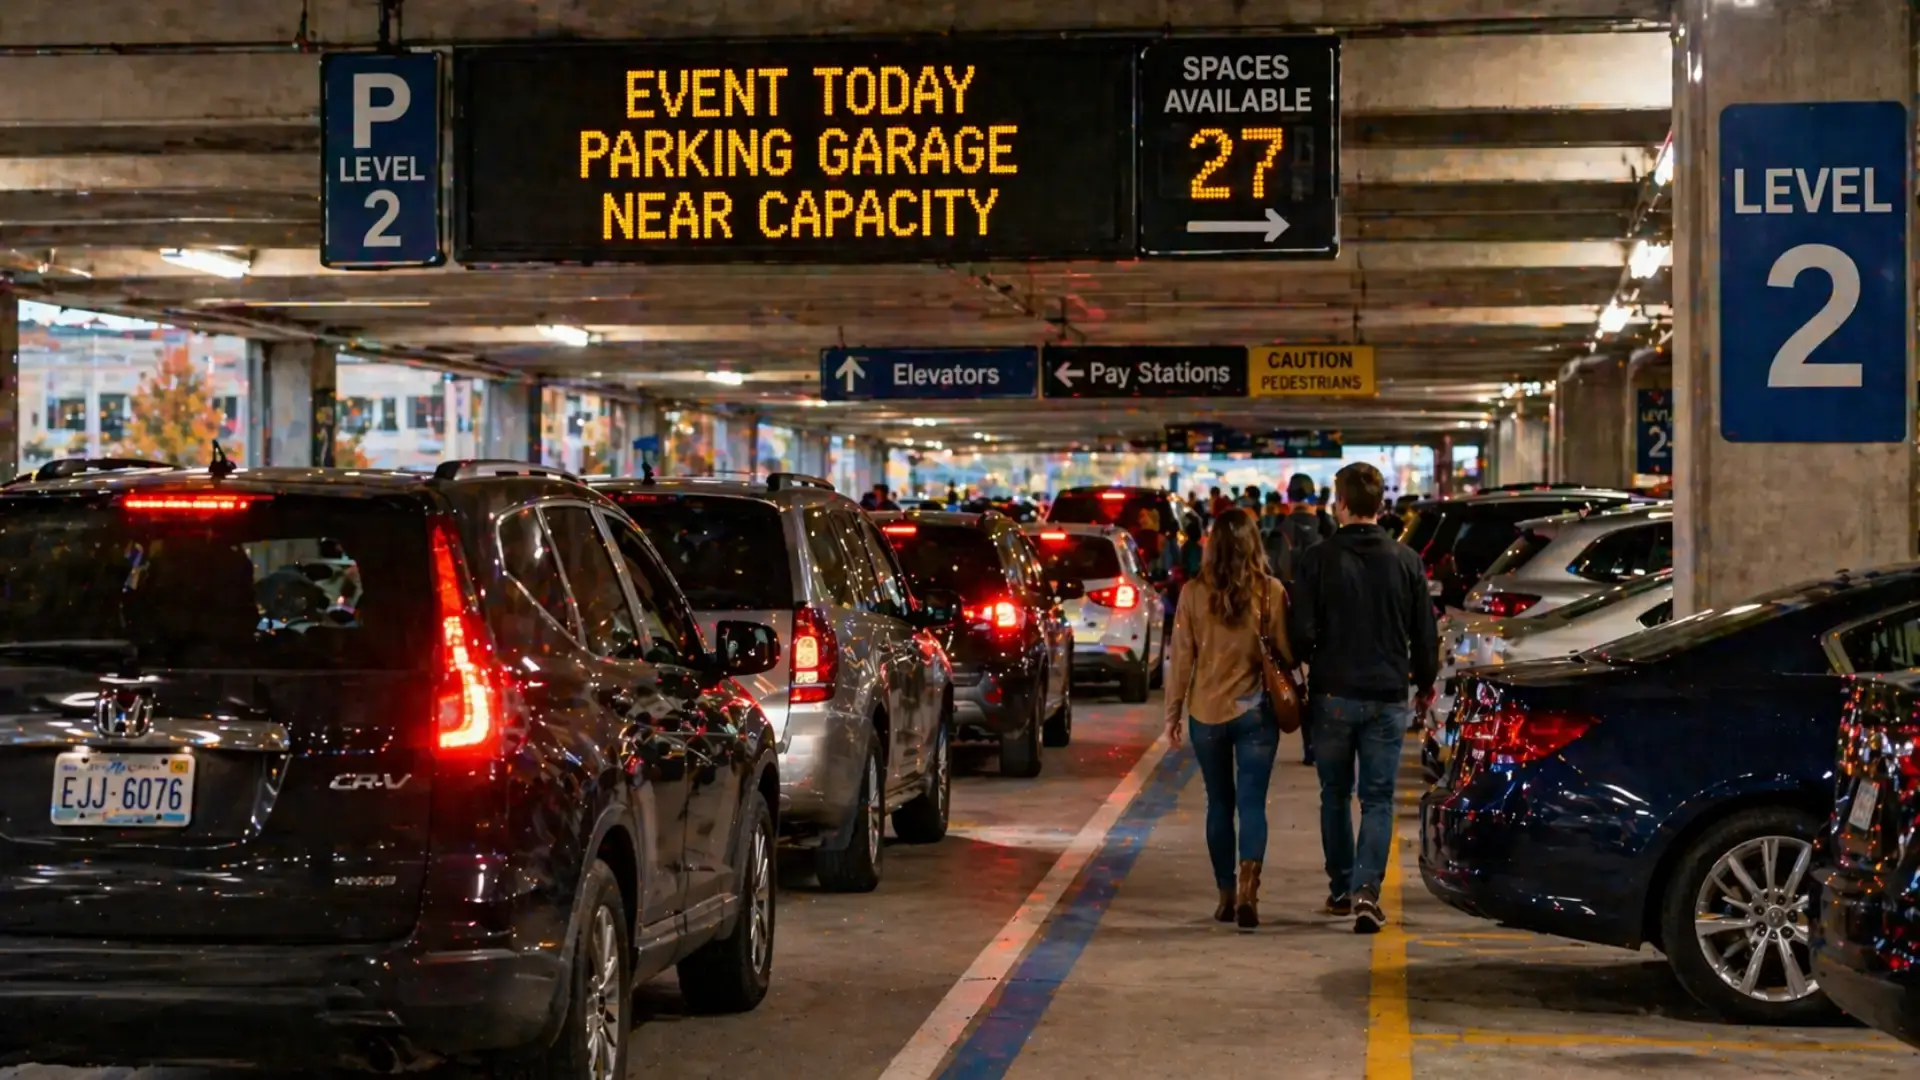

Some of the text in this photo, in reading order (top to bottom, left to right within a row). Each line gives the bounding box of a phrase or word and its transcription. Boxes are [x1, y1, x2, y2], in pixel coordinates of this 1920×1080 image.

[1183, 55, 1289, 80] SPACES
[626, 65, 975, 118] EVENT TODAY
[1164, 87, 1312, 113] AVAILABLE
[354, 73, 410, 148] P
[580, 125, 1018, 178] PARKING GARAGE
[1190, 128, 1283, 199] 27
[340, 156, 425, 182] LEVEL
[1734, 167, 1893, 213] LEVEL
[363, 190, 401, 247] 2
[603, 188, 999, 240] NEAR CAPACITY
[1767, 243, 1863, 387] 2
[893, 363, 1000, 385] Elevators
[1090, 362, 1230, 388] Pay Stations
[1267, 351, 1354, 369] CAUTION
[1261, 375, 1362, 390] PEDESTRIANS
[1648, 425, 1667, 457] 2
[329, 773, 413, 790] CR-V
